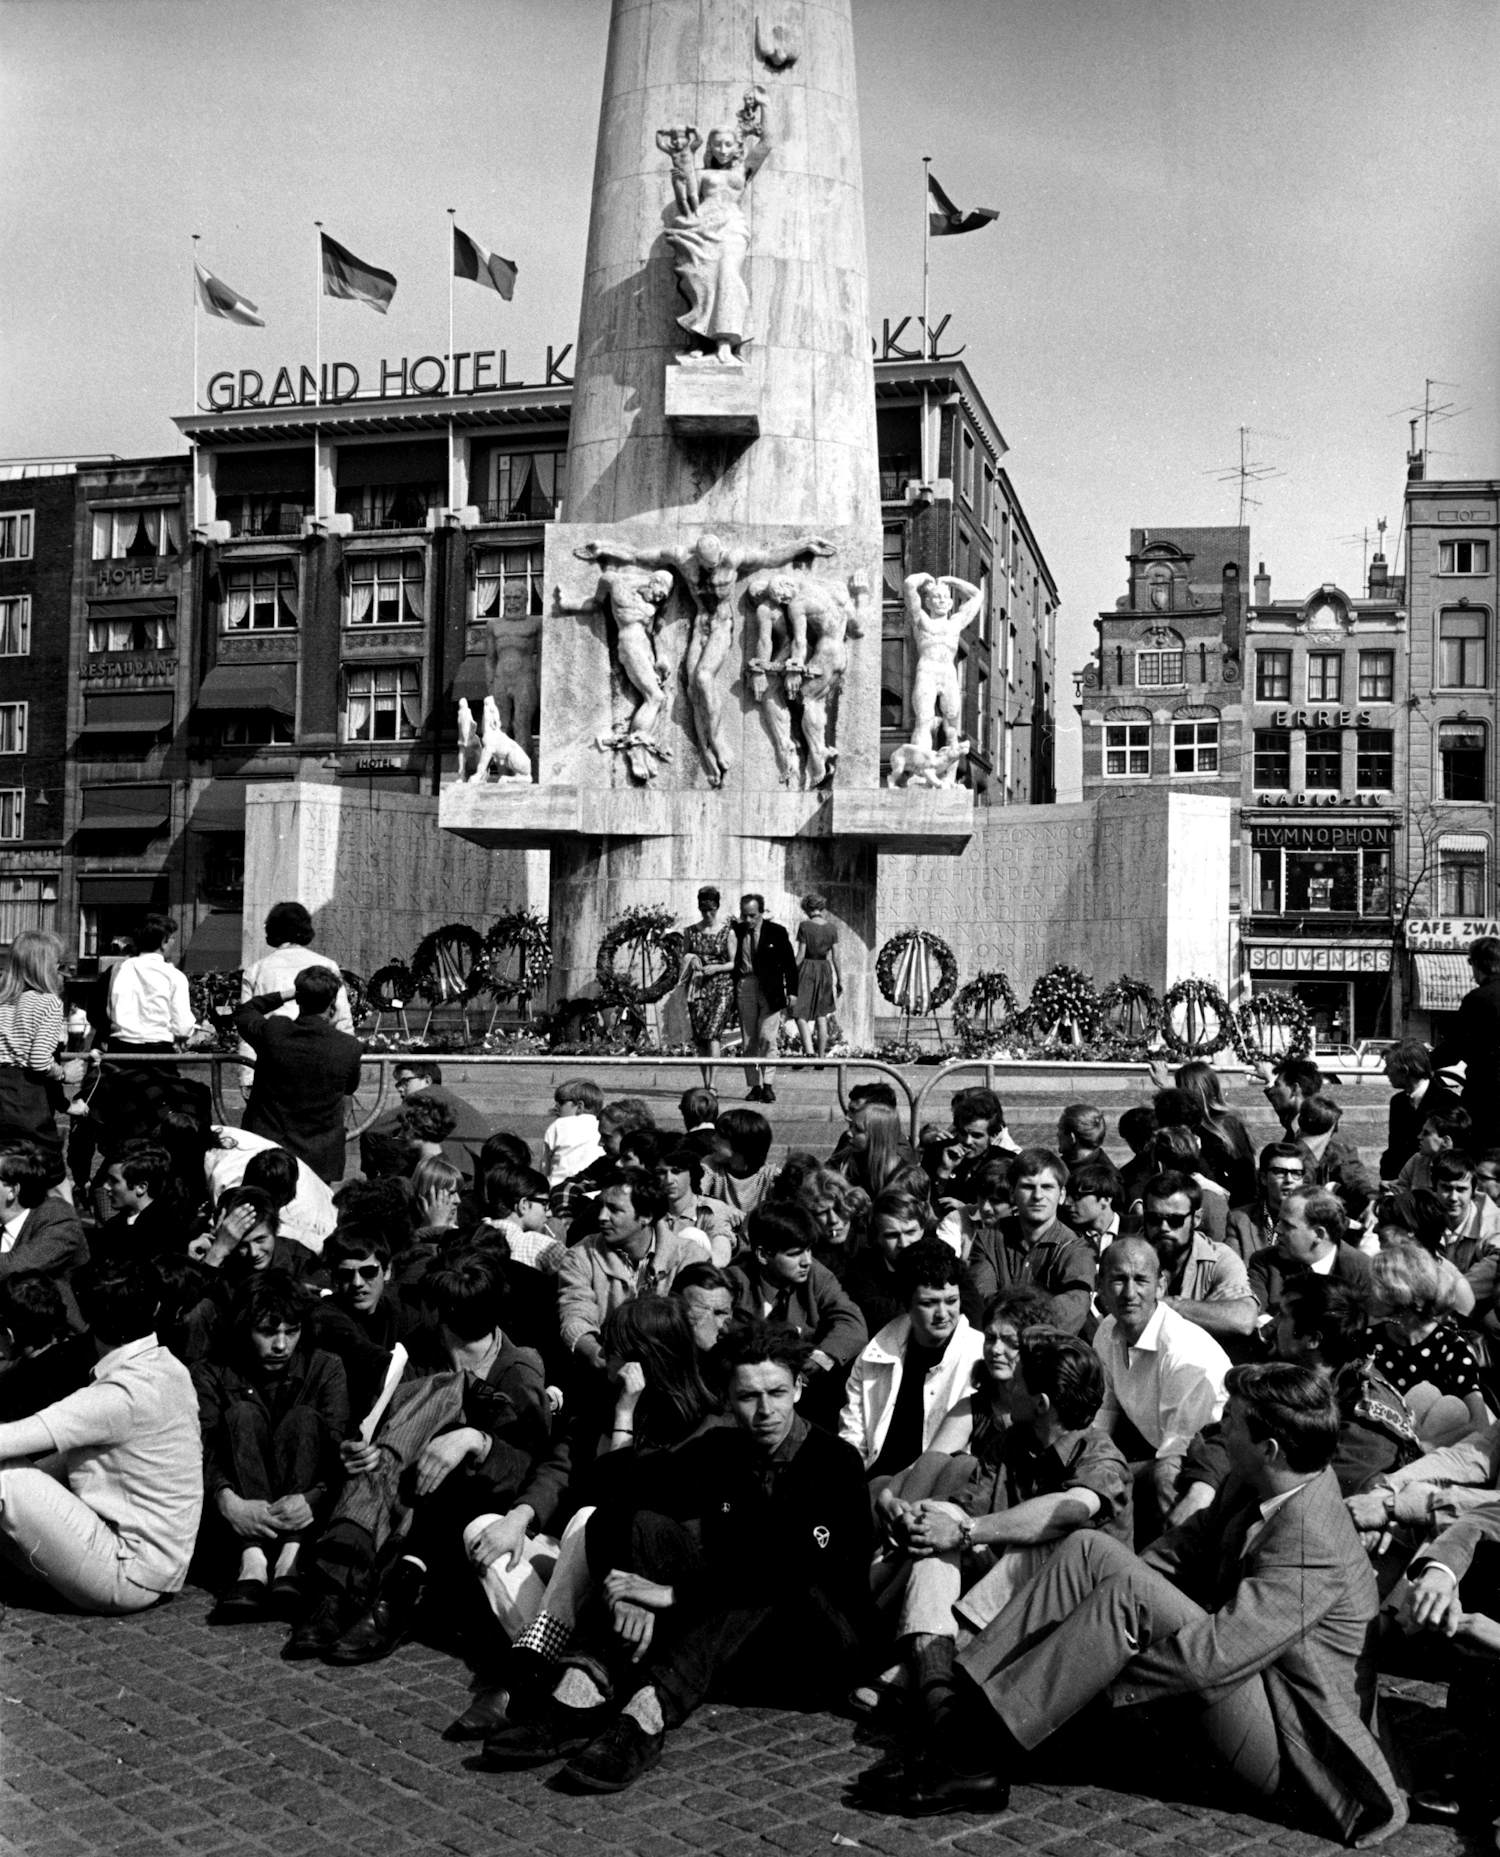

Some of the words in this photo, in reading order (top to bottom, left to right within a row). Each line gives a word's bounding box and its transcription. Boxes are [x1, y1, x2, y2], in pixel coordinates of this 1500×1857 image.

[207, 362, 360, 409] GRAND
[380, 350, 523, 397] HOTEL
[96, 566, 168, 586] HOTEL
[79, 658, 178, 679] RESTAURANT
[1275, 710, 1373, 727] ERRES
[1256, 828, 1388, 844] HYMNOPHON
[1408, 921, 1452, 935] CAFE
[1408, 936, 1471, 950] Heineke
[1252, 949, 1389, 969] SOUVENIRS
